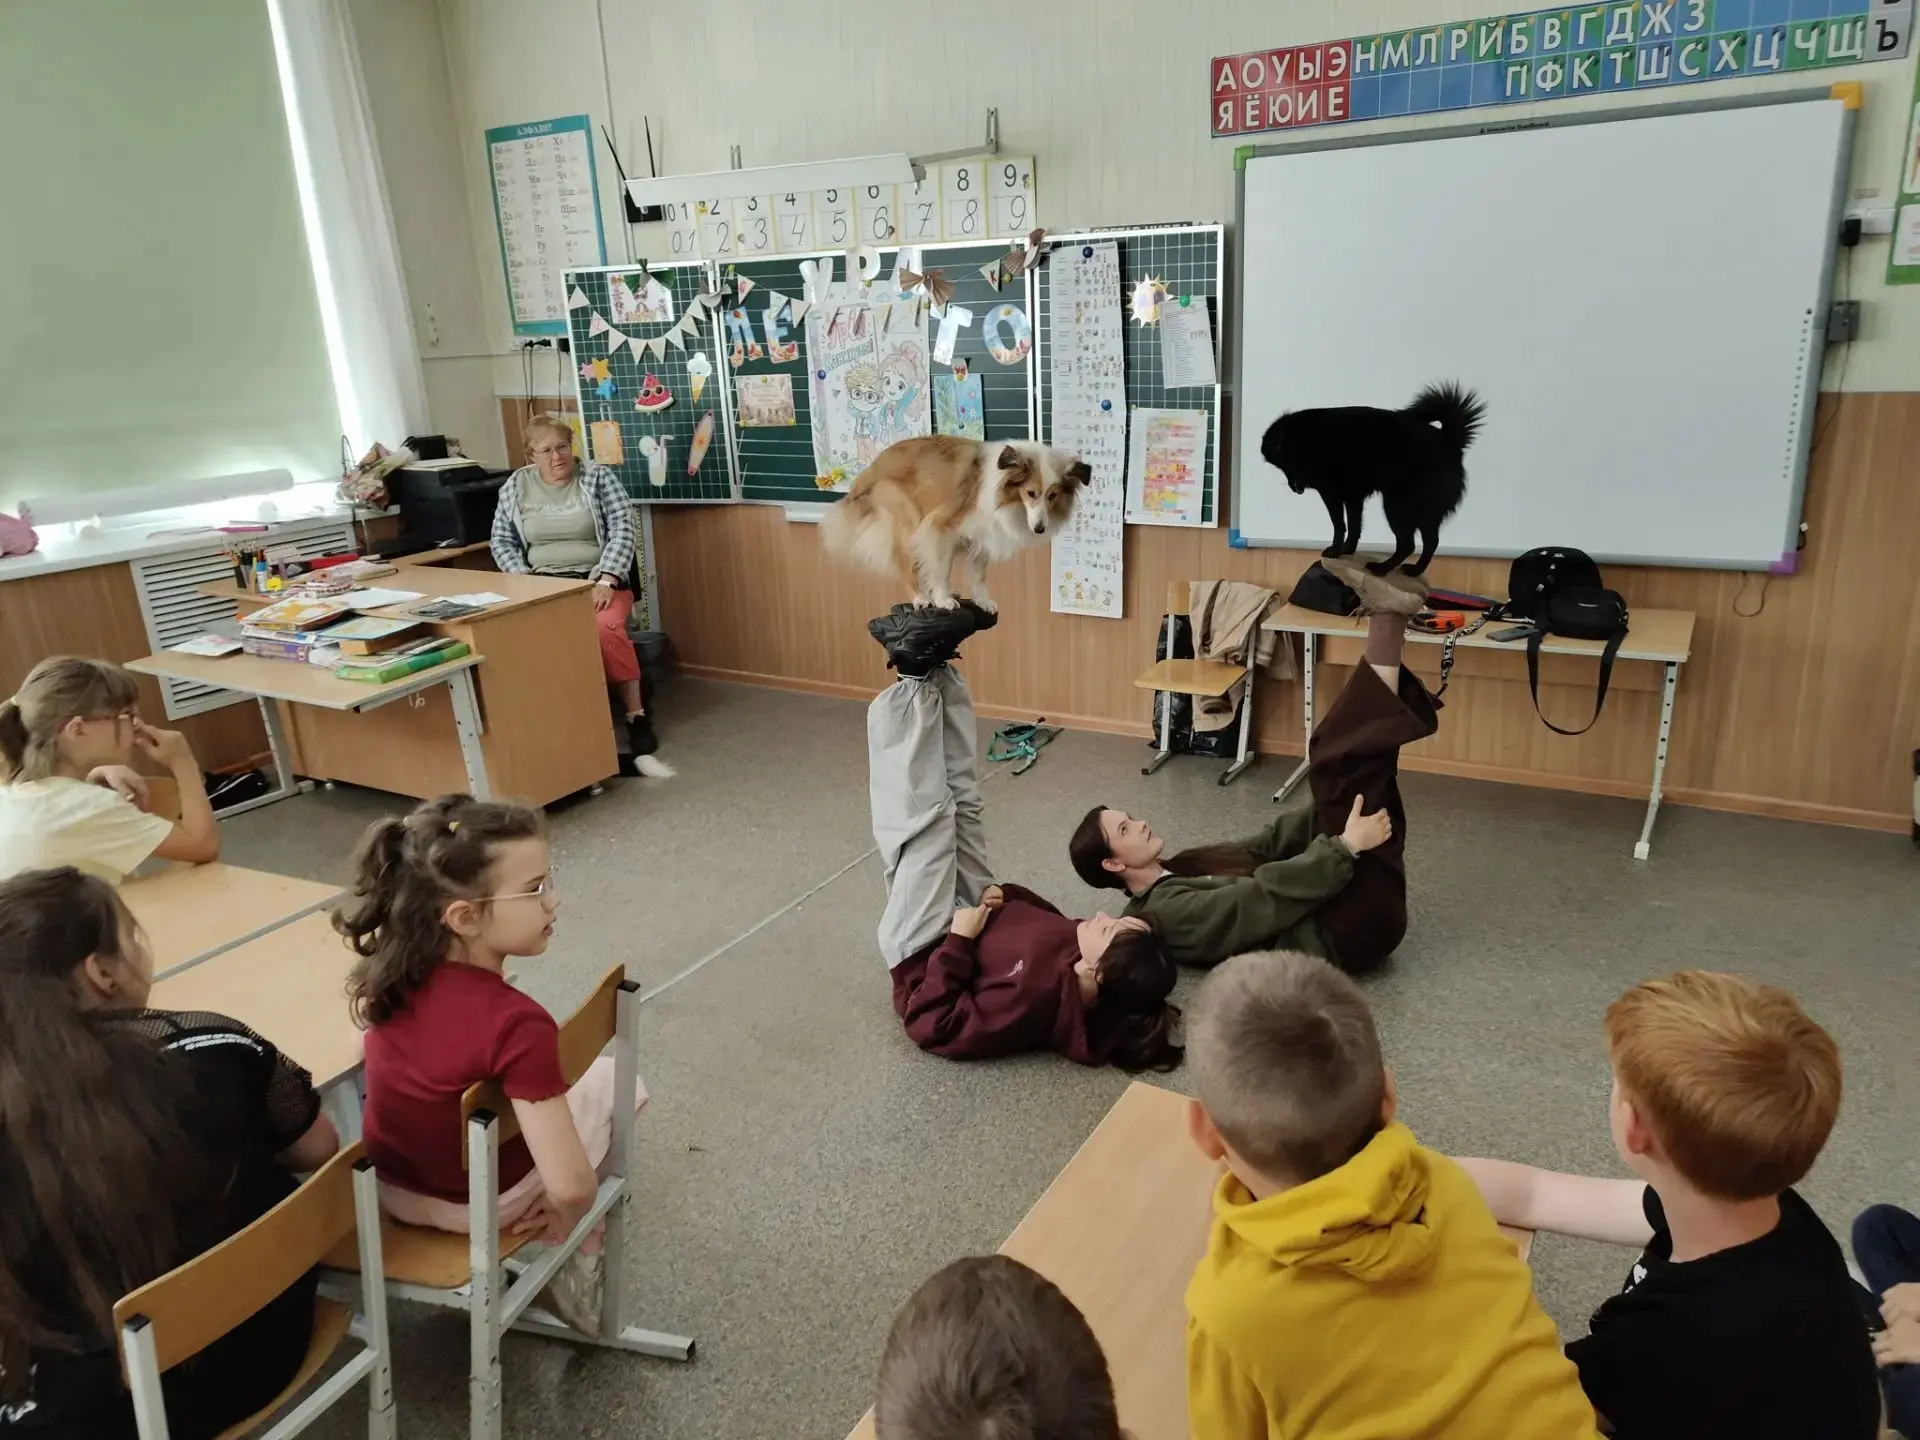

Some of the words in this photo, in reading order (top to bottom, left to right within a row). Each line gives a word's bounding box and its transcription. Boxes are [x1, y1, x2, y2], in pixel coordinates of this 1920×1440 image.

[1216, 63, 1237, 92] А
[1242, 58, 1266, 88] О
[1271, 53, 1291, 84] У
[1299, 50, 1322, 80] Ы
[1328, 46, 1347, 77] Э
[1450, 28, 1468, 61] Р
[1510, 22, 1529, 55] Б
[1543, 17, 1562, 50] В
[1606, 7, 1634, 46] Д
[1641, 2, 1672, 37] Ж
[1218, 101, 1234, 130] Я
[1246, 94, 1260, 127] Ё
[1268, 93, 1293, 124] Ю
[1298, 90, 1317, 121] И
[1328, 86, 1344, 117] Е
[1572, 55, 1594, 89] К
[1875, 19, 1899, 52] Ъ
[957, 168, 969, 191] 8
[1004, 164, 1017, 187] 9
[717, 222, 731, 253] 2
[754, 218, 768, 249] 3
[791, 215, 806, 245] 4
[832, 210, 847, 242] 5
[873, 206, 888, 239] 6
[918, 203, 932, 236] 7
[961, 199, 977, 233] 8
[1009, 196, 1026, 230] 9
